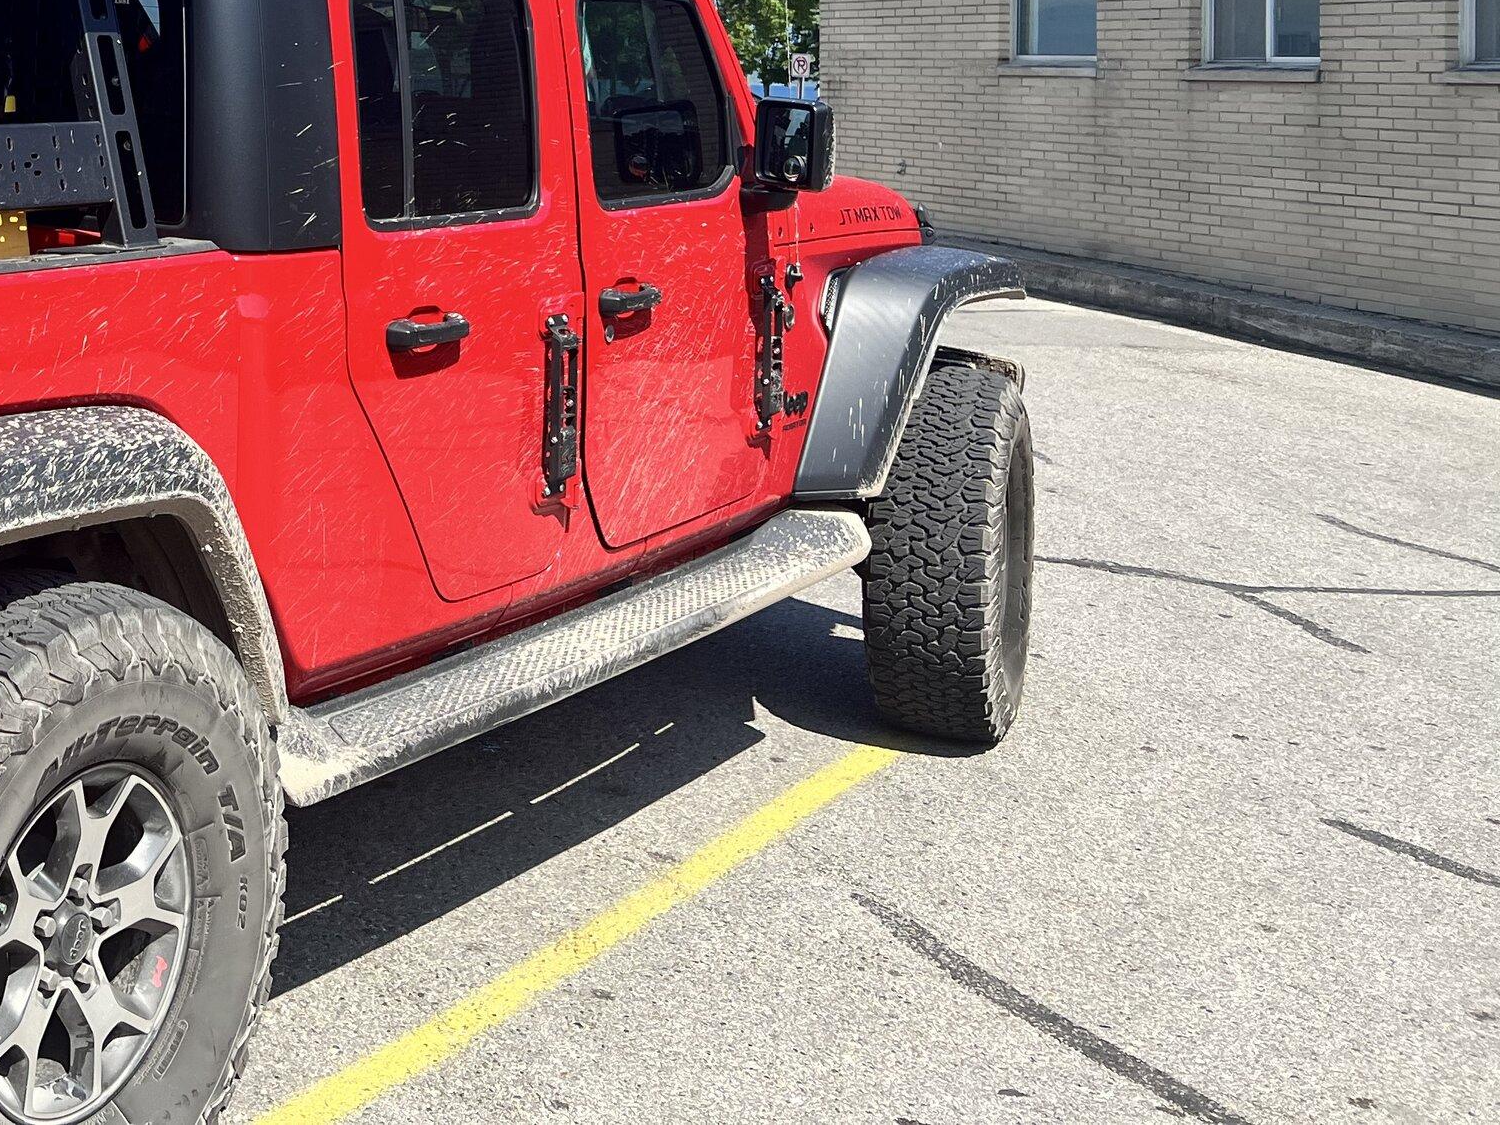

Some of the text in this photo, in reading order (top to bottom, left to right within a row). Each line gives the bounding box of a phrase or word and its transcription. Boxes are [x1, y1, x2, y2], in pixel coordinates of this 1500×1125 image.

[839, 205, 902, 226] JT MAX TOW
[217, 783, 247, 863] T/A
